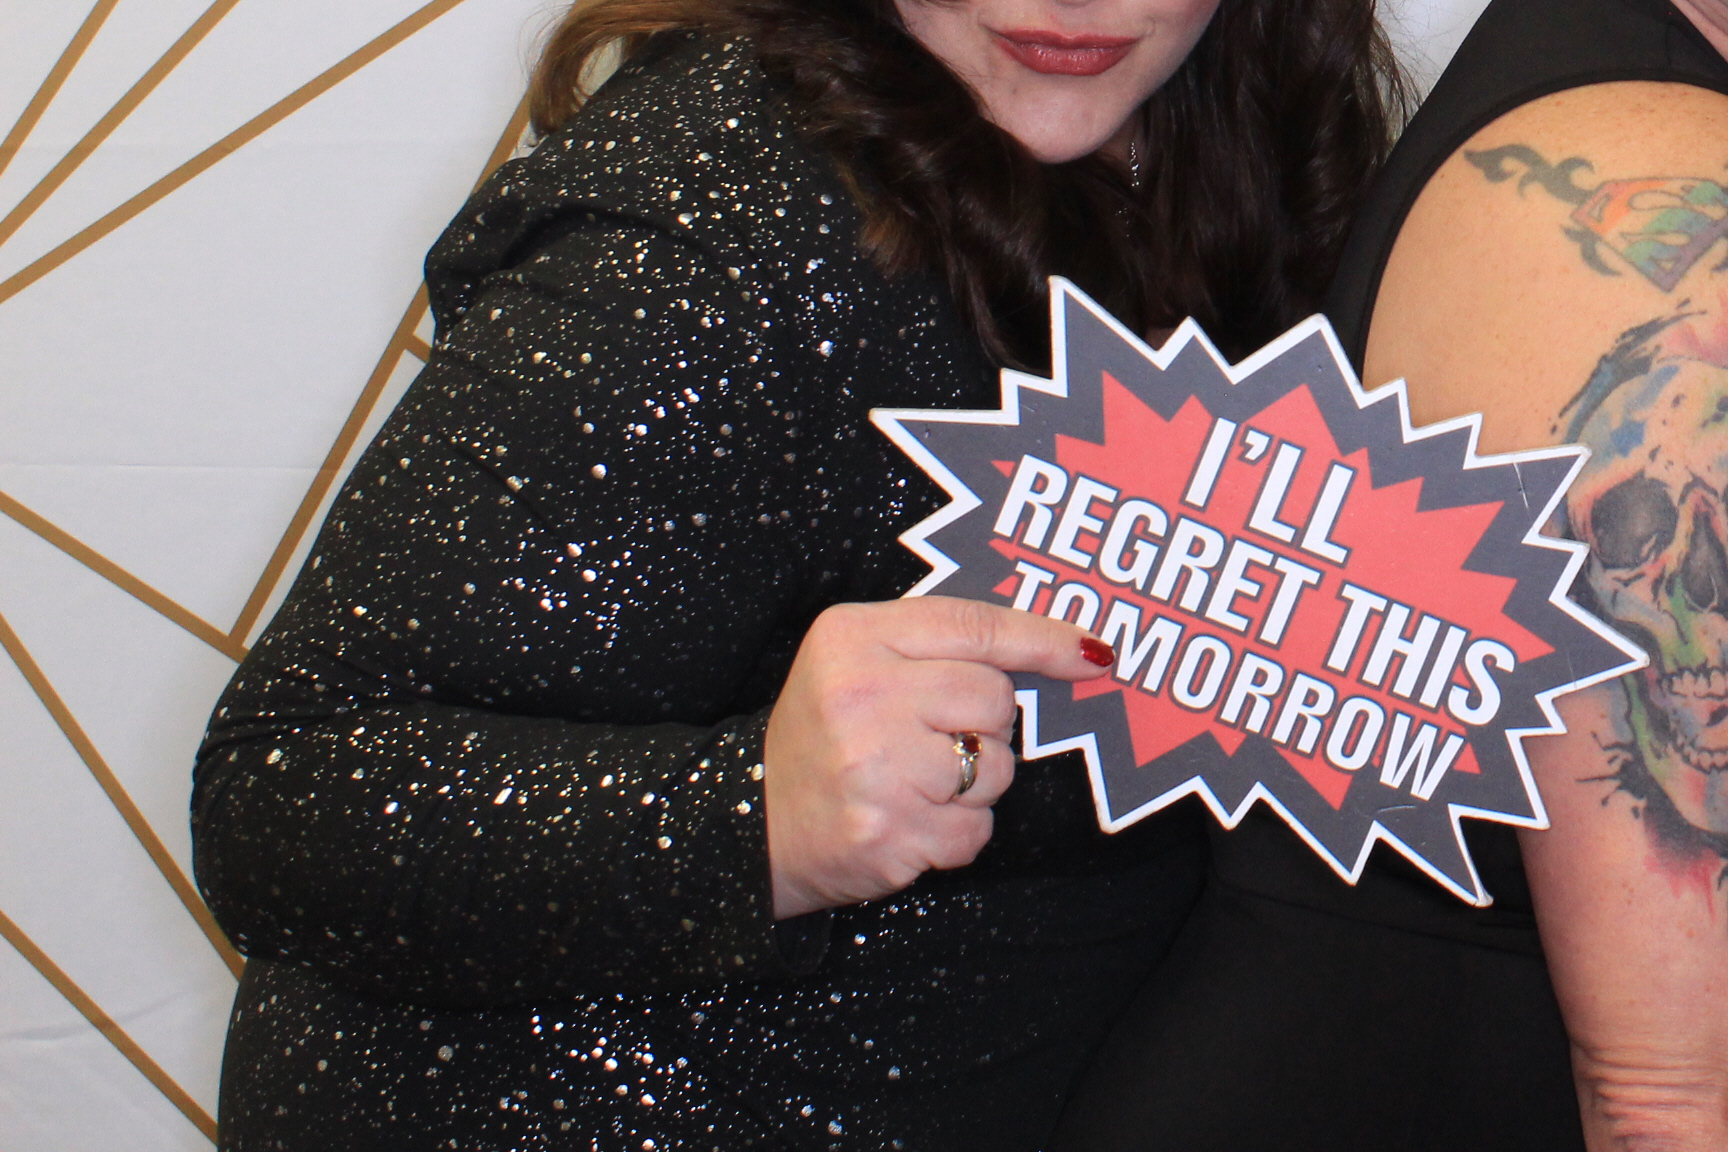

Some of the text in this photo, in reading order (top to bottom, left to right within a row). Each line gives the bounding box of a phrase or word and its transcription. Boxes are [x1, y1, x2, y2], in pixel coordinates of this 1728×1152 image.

[993, 453, 1516, 725] REGRET THIS
[1184, 417, 1354, 564] I'LL
